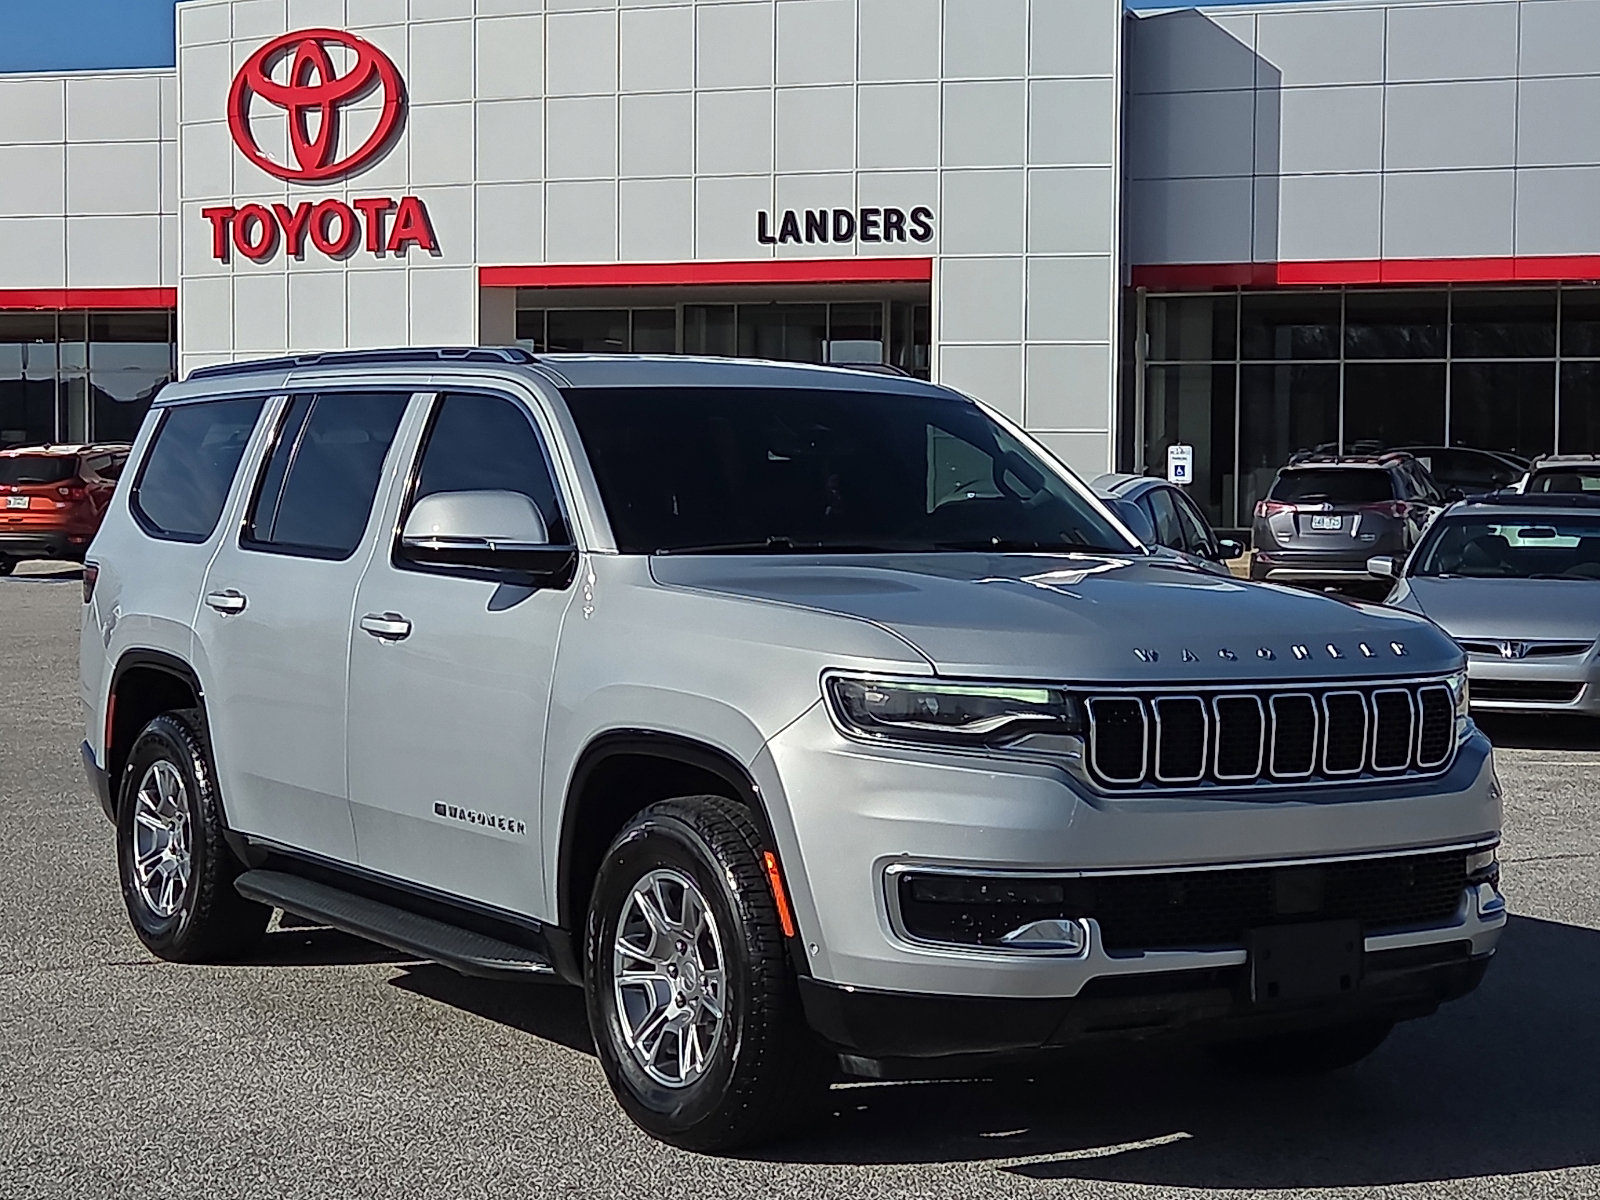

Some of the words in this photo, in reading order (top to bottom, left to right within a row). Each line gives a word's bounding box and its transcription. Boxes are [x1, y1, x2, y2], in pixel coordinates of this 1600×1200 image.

[202, 196, 443, 264] TOYOTA
[757, 206, 934, 244] LANDERS
[1133, 641, 1409, 663] WAGONEER
[448, 804, 526, 836] WAGONEER
